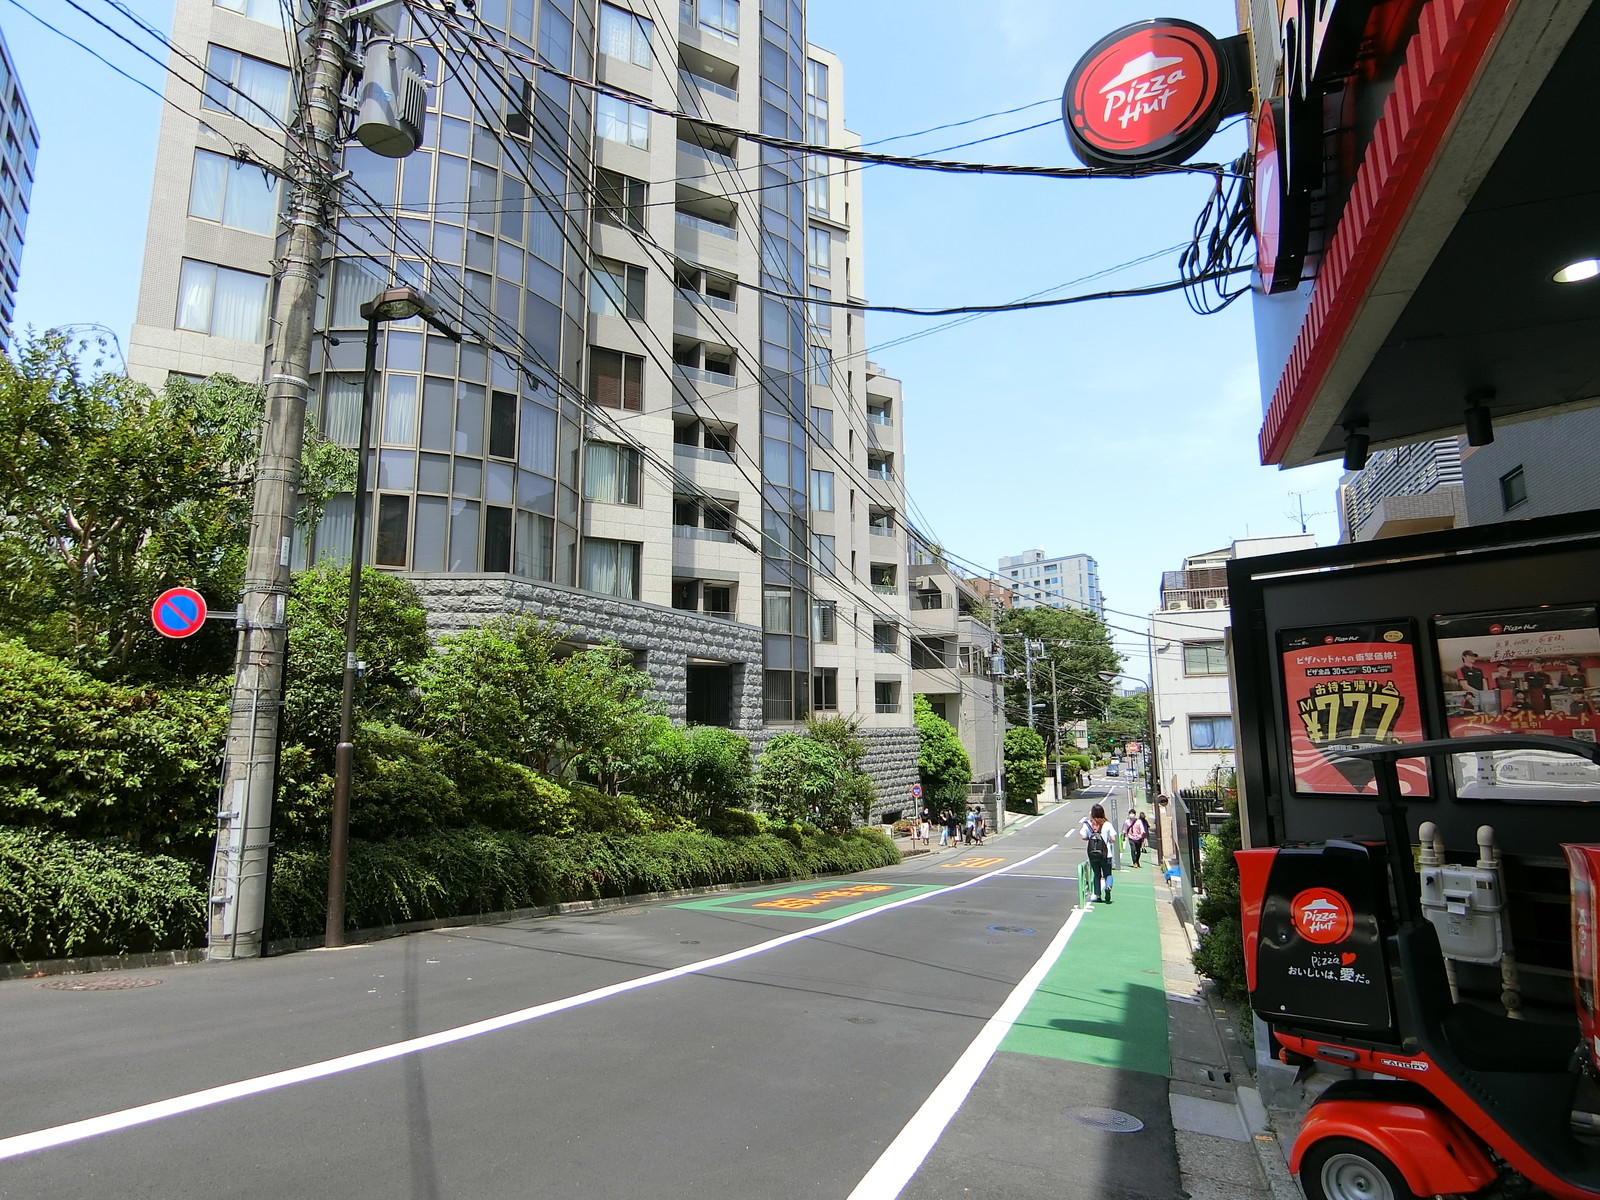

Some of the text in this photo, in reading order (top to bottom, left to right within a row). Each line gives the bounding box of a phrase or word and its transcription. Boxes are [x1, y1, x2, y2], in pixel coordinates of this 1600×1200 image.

[1103, 68, 1186, 122] Pizza
[1119, 88, 1178, 129] Hut
[1315, 680, 1377, 696] お持ち帰り
[941, 857, 1006, 868] 30
[1302, 910, 1338, 925] Pizza
[1309, 920, 1337, 934] Hut
[1288, 966, 1370, 984] おいしいは、愛だ。
[1382, 1060, 1428, 1070] CANOPY
